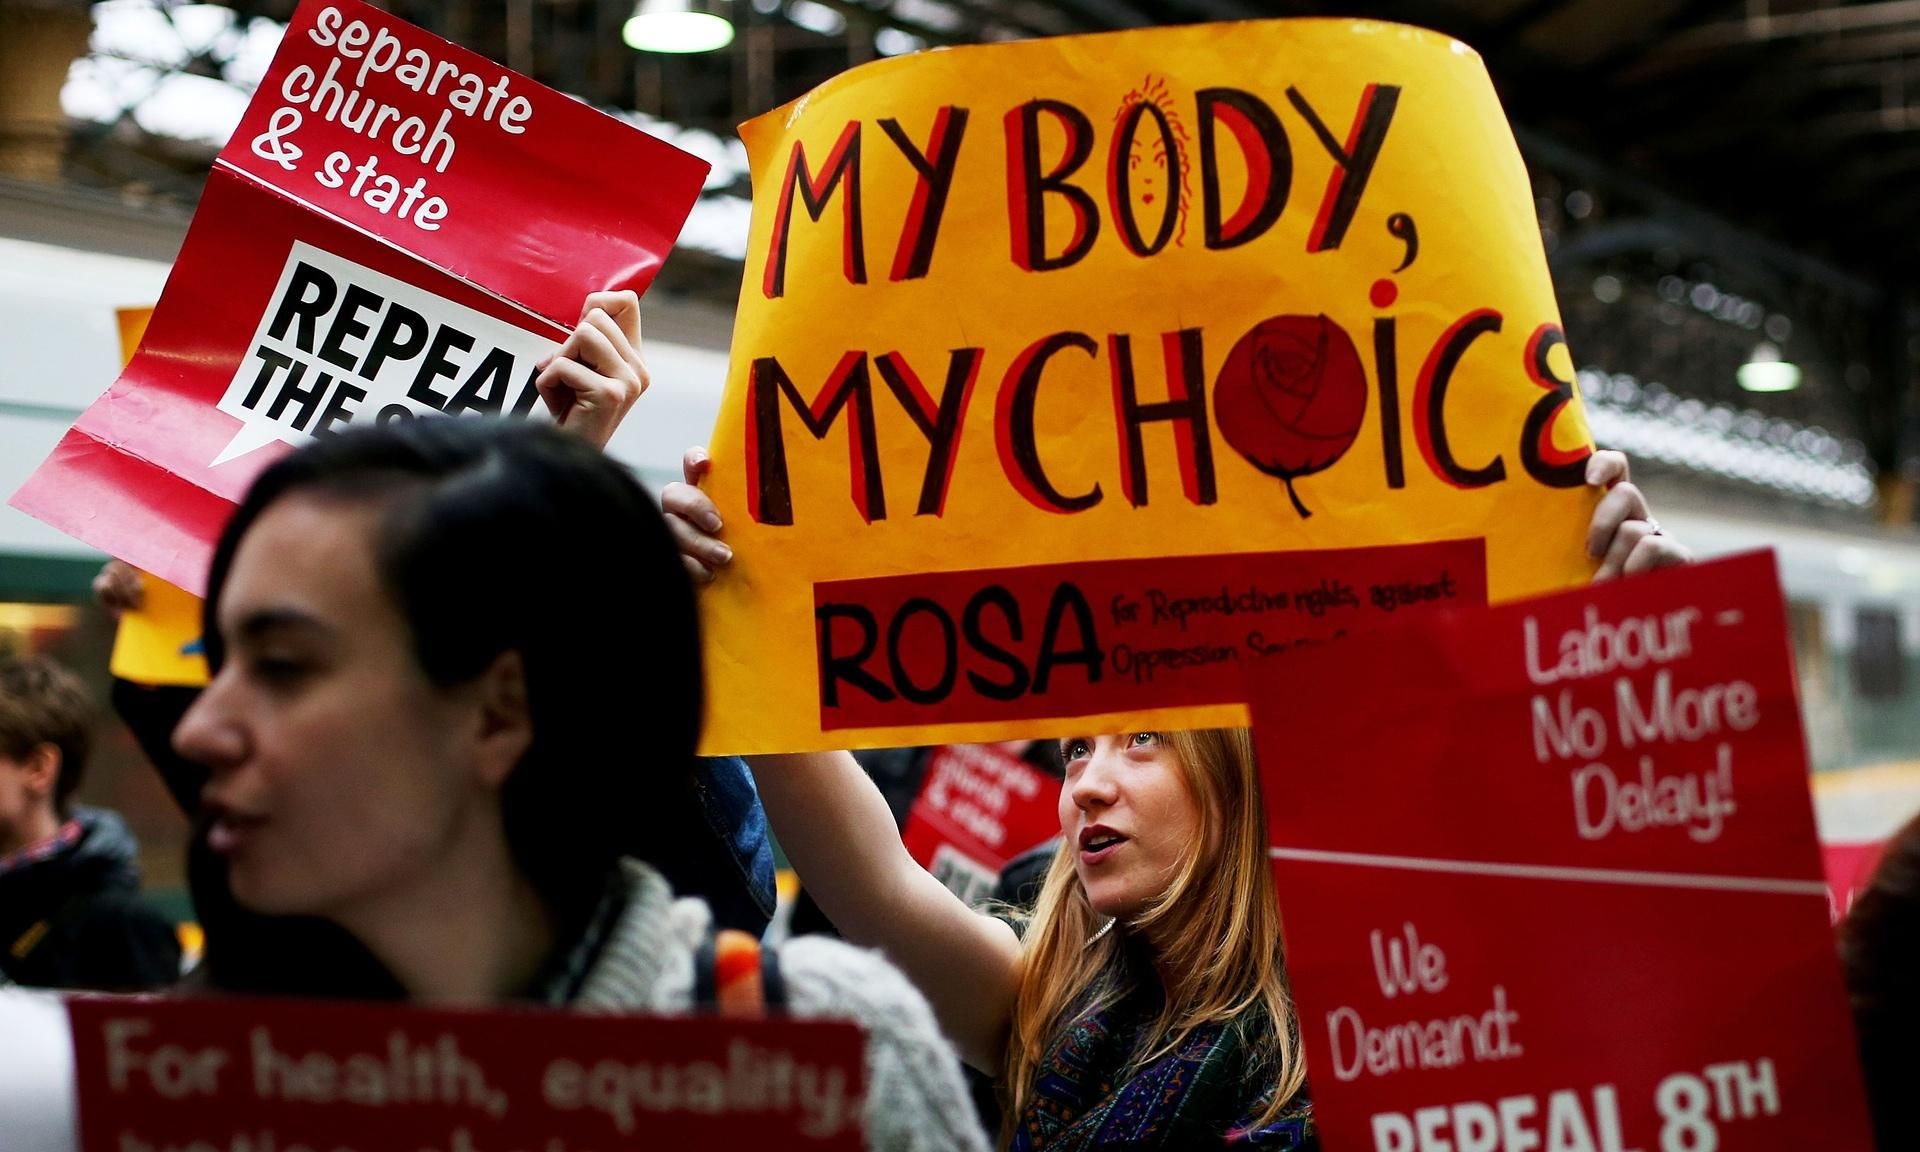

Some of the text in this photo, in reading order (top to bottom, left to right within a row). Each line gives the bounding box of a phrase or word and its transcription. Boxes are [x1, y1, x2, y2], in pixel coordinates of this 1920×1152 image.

[282, 57, 457, 173] church
[309, 5, 533, 134] separate
[251, 106, 449, 231] & state
[762, 82, 1419, 299] MY BODY,
[241, 345, 368, 440] THE
[744, 347, 985, 526] MY
[814, 582, 1106, 708] ROSA
[1110, 592, 1141, 626] for
[1370, 572, 1457, 612] against
[1524, 606, 1701, 686] Labour
[1111, 643, 1239, 683] Oppression
[1531, 670, 1760, 763] No More
[1571, 743, 1739, 842] Delay!
[1369, 920, 1449, 999] We
[101, 1017, 230, 1099] For
[250, 1024, 508, 1120] health,
